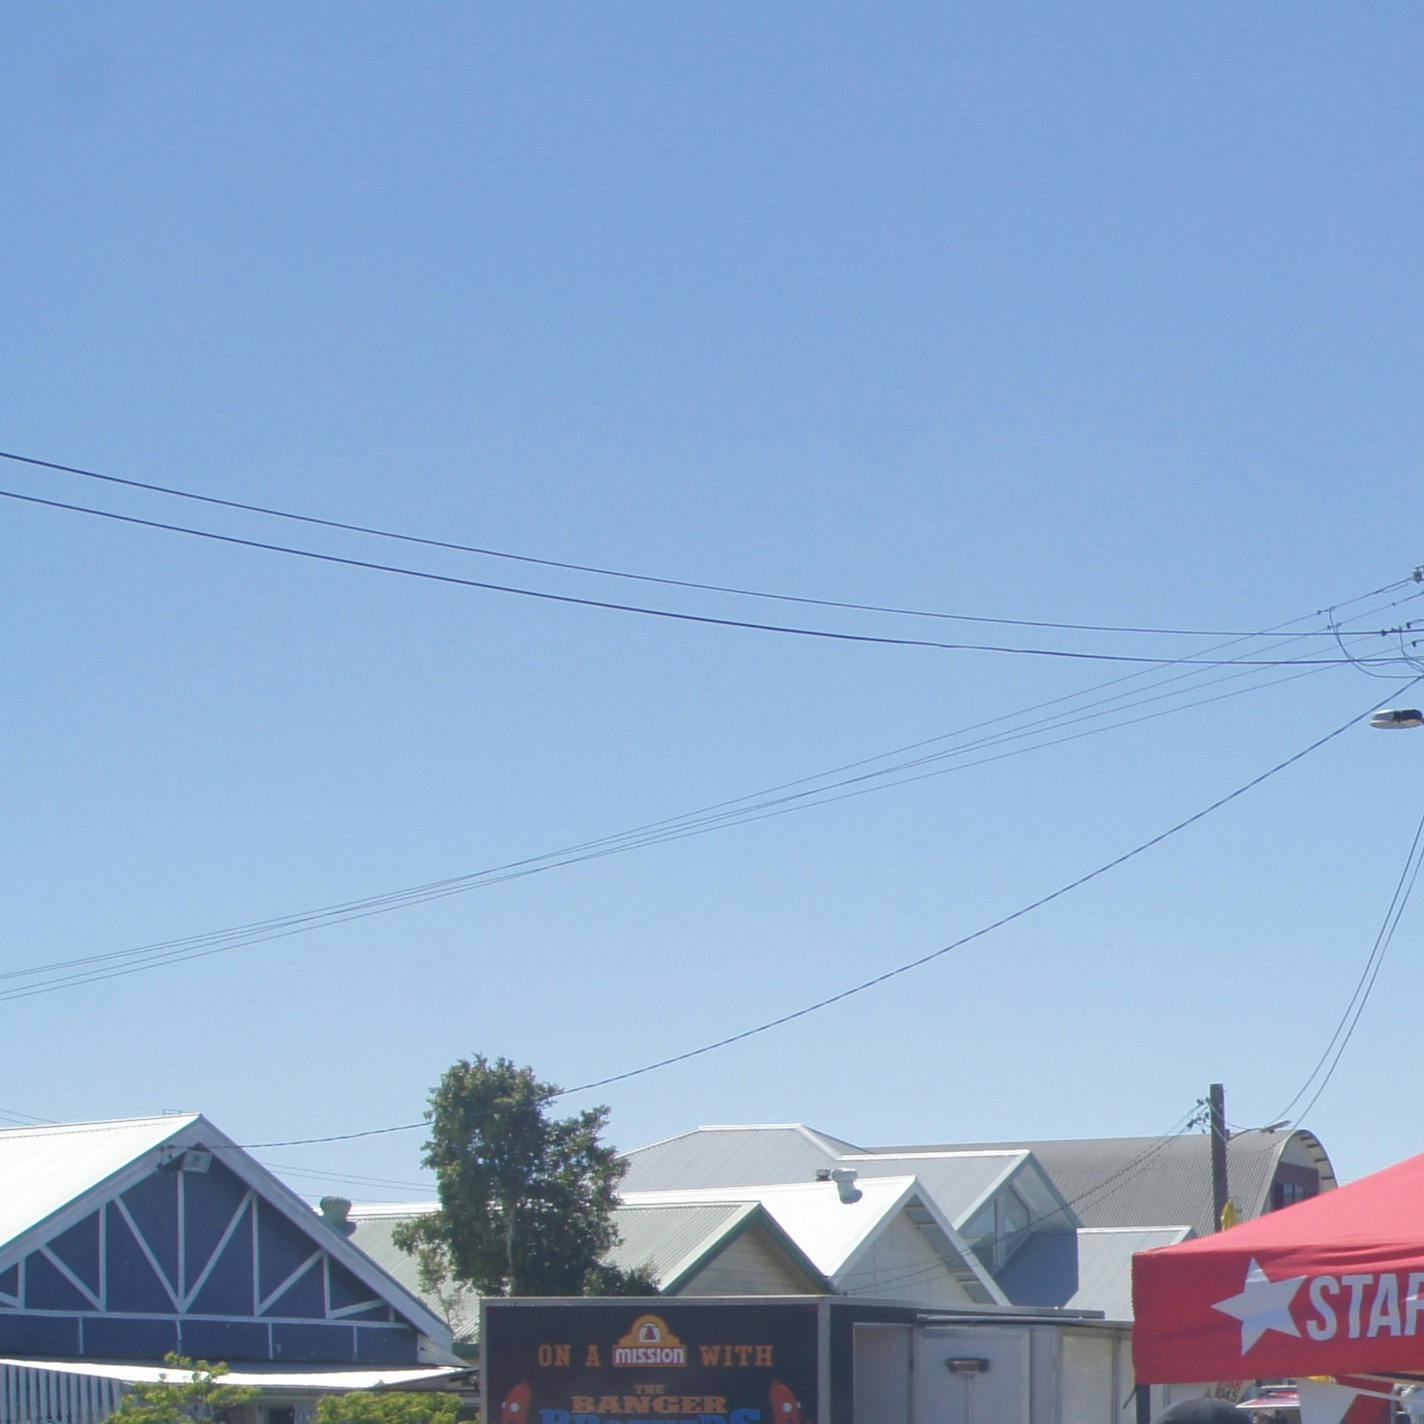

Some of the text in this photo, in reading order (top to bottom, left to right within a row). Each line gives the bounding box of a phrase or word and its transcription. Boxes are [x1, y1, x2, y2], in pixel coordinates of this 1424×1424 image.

[538, 1345, 571, 1367] ON
[585, 1345, 601, 1367] A
[702, 1345, 774, 1367] WITH
[634, 1384, 665, 1395] THE
[571, 1396, 729, 1414] BANGER
